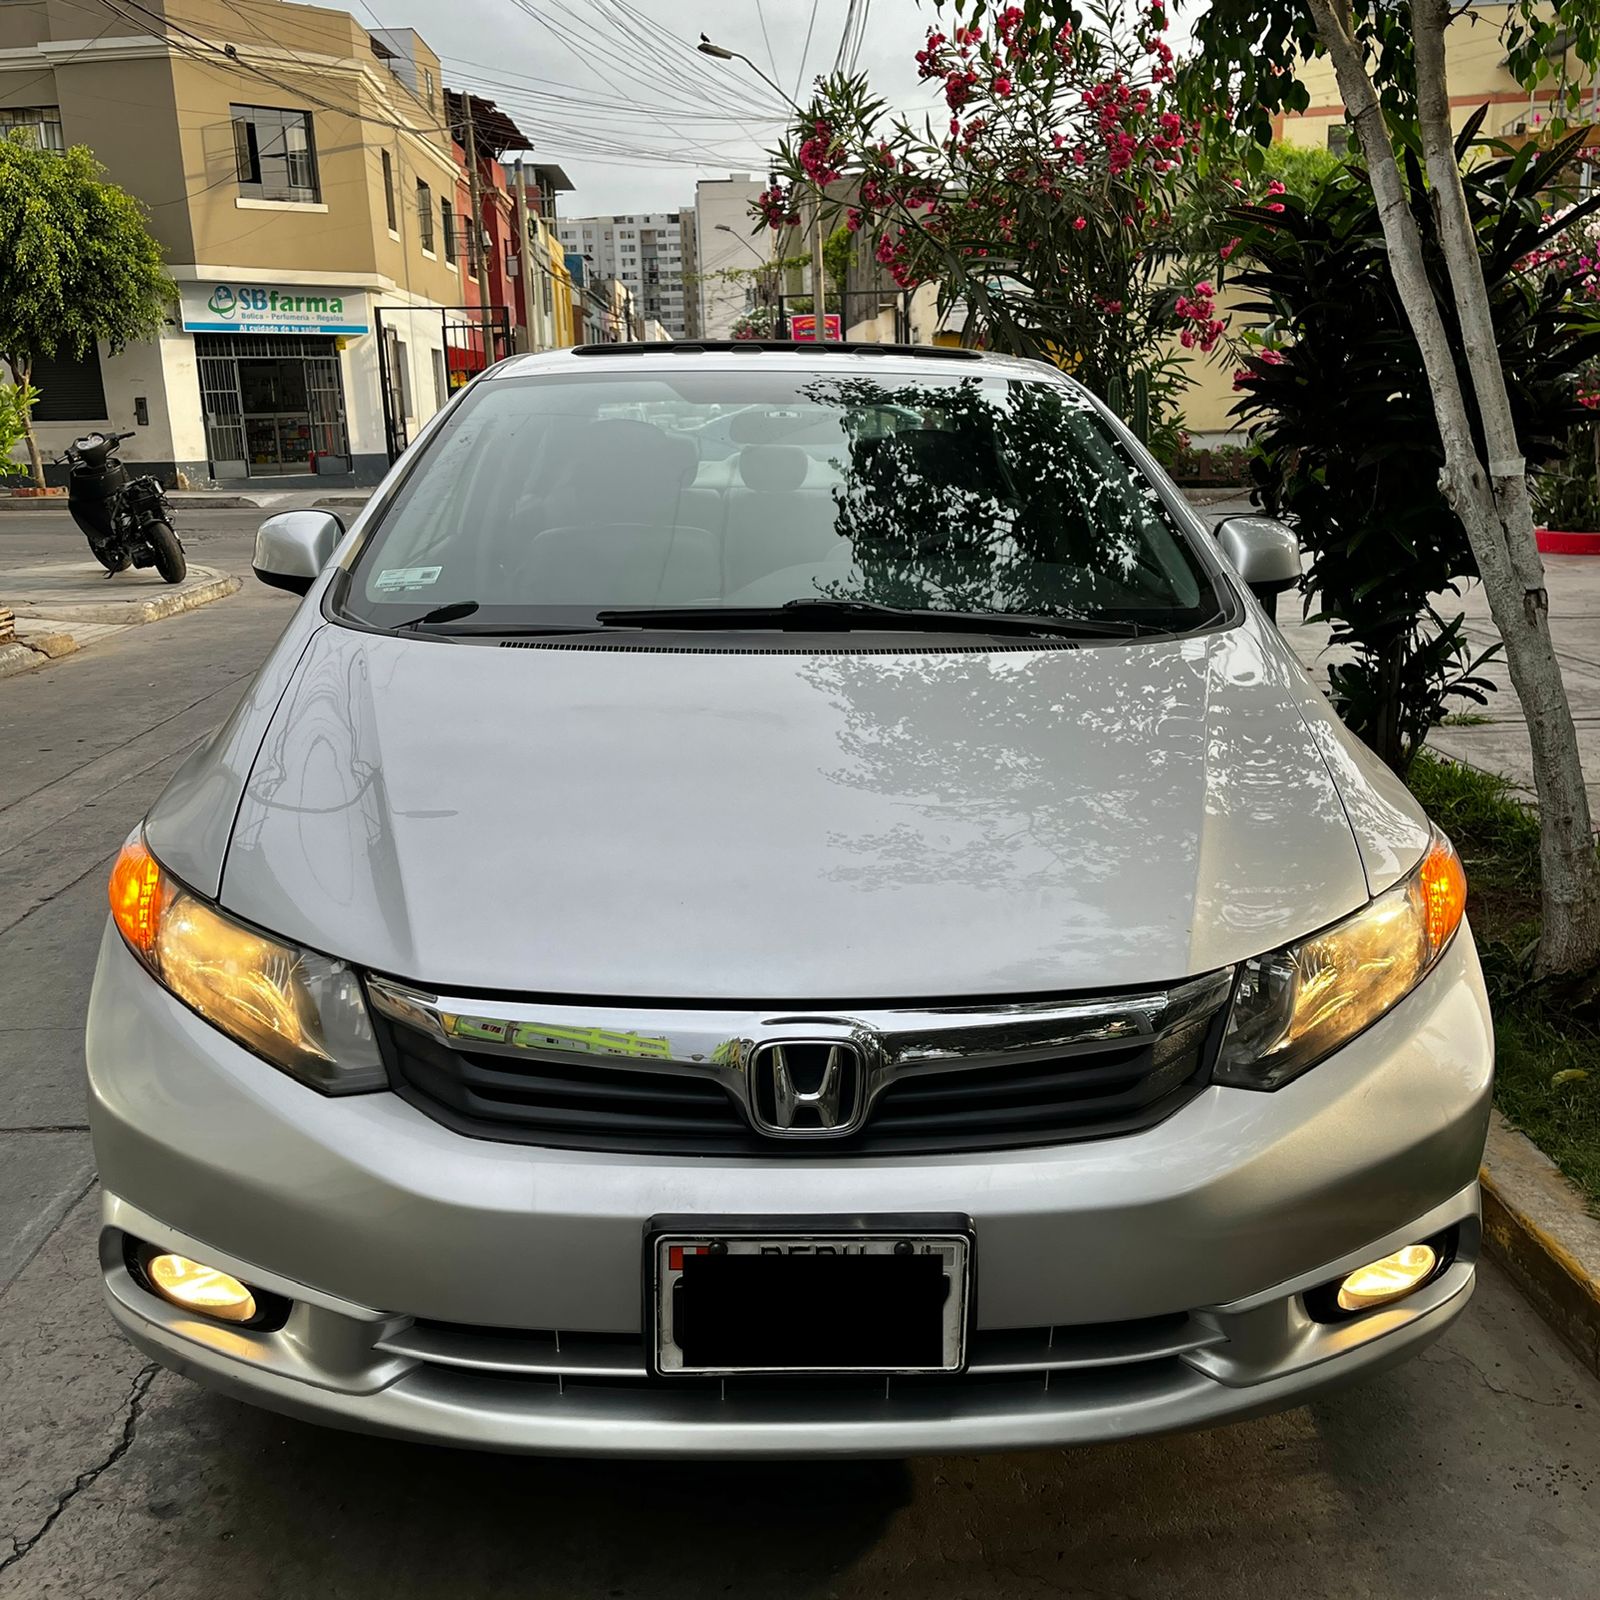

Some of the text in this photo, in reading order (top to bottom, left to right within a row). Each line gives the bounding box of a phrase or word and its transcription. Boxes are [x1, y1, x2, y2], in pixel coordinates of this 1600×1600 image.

[241, 312, 264, 320] Botica
[317, 314, 344, 322] Regalos
[250, 324, 278, 333] cuidado
[280, 325, 289, 333] de
